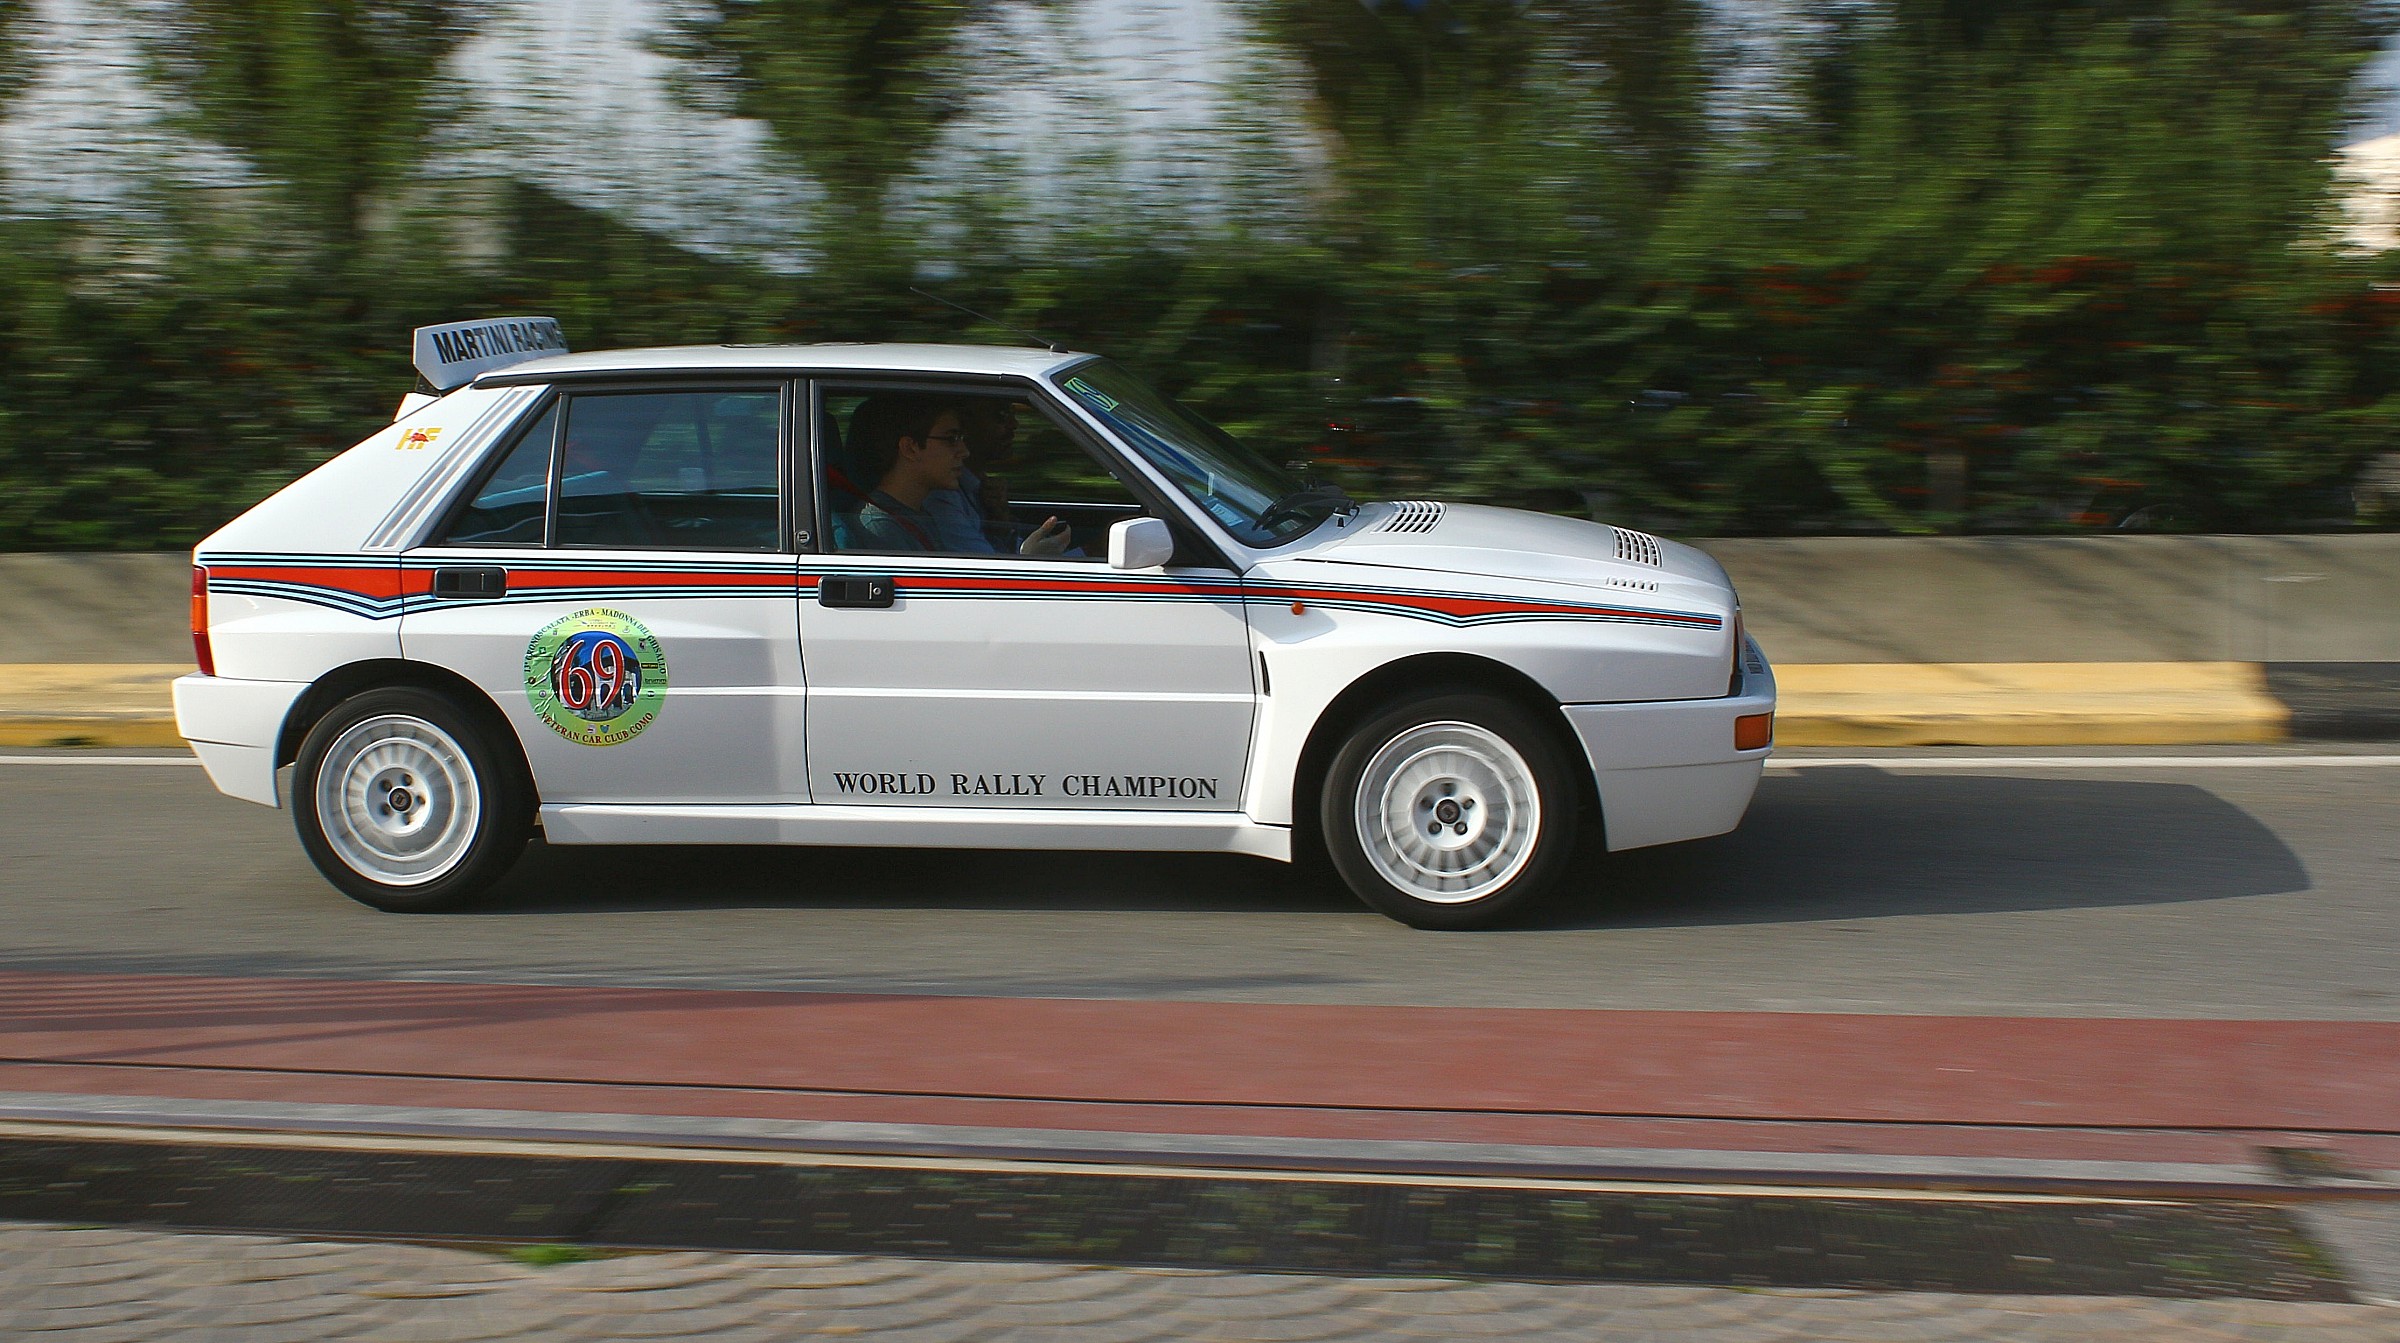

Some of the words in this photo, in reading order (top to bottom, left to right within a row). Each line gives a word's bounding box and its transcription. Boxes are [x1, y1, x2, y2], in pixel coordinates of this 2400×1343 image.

[432, 324, 513, 364] MARTINI
[395, 428, 442, 450] HF
[601, 608, 637, 626] MADONNA
[637, 624, 649, 635] DEL
[560, 640, 625, 709] 69
[542, 712, 580, 740] VETERAN
[582, 735, 602, 743] CAR
[604, 730, 629, 743] CLUB
[630, 712, 653, 734] COMO
[833, 773, 936, 794] WORLD
[950, 774, 1046, 795] RALLY
[1062, 774, 1218, 799] CHAMPION
